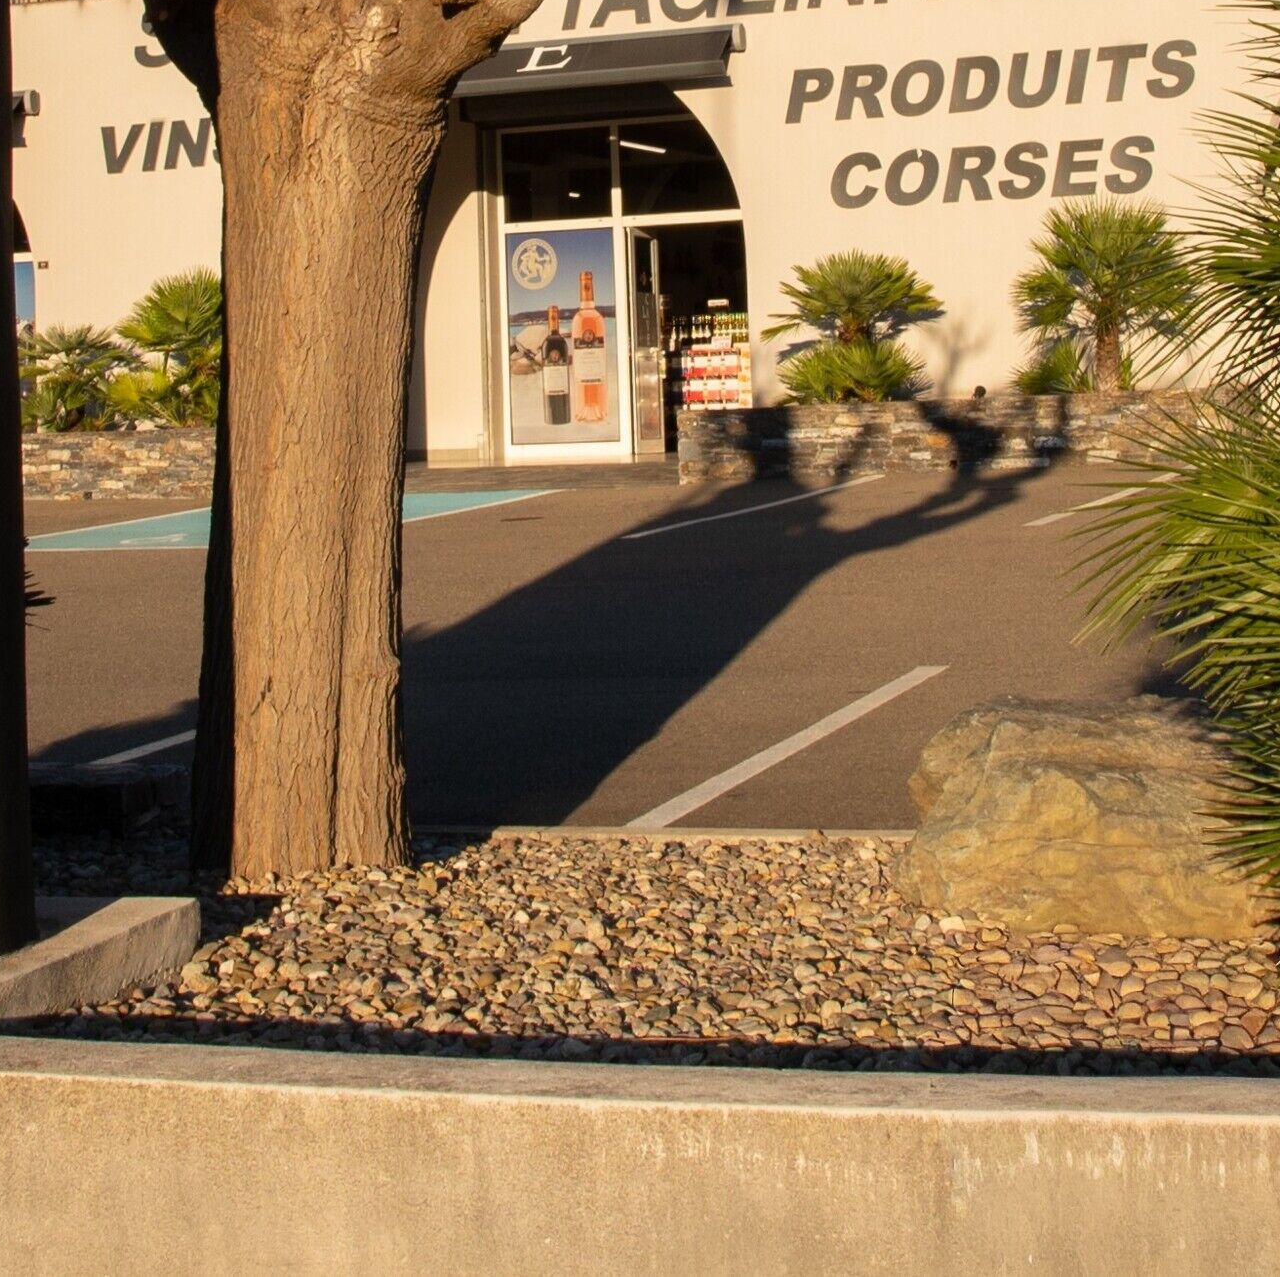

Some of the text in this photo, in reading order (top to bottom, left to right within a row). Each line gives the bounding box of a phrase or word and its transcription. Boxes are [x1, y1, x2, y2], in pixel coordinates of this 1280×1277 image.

[784, 39, 1198, 125] PRODUITS
[100, 117, 220, 175] VIN
[829, 134, 1156, 210] CORSES
